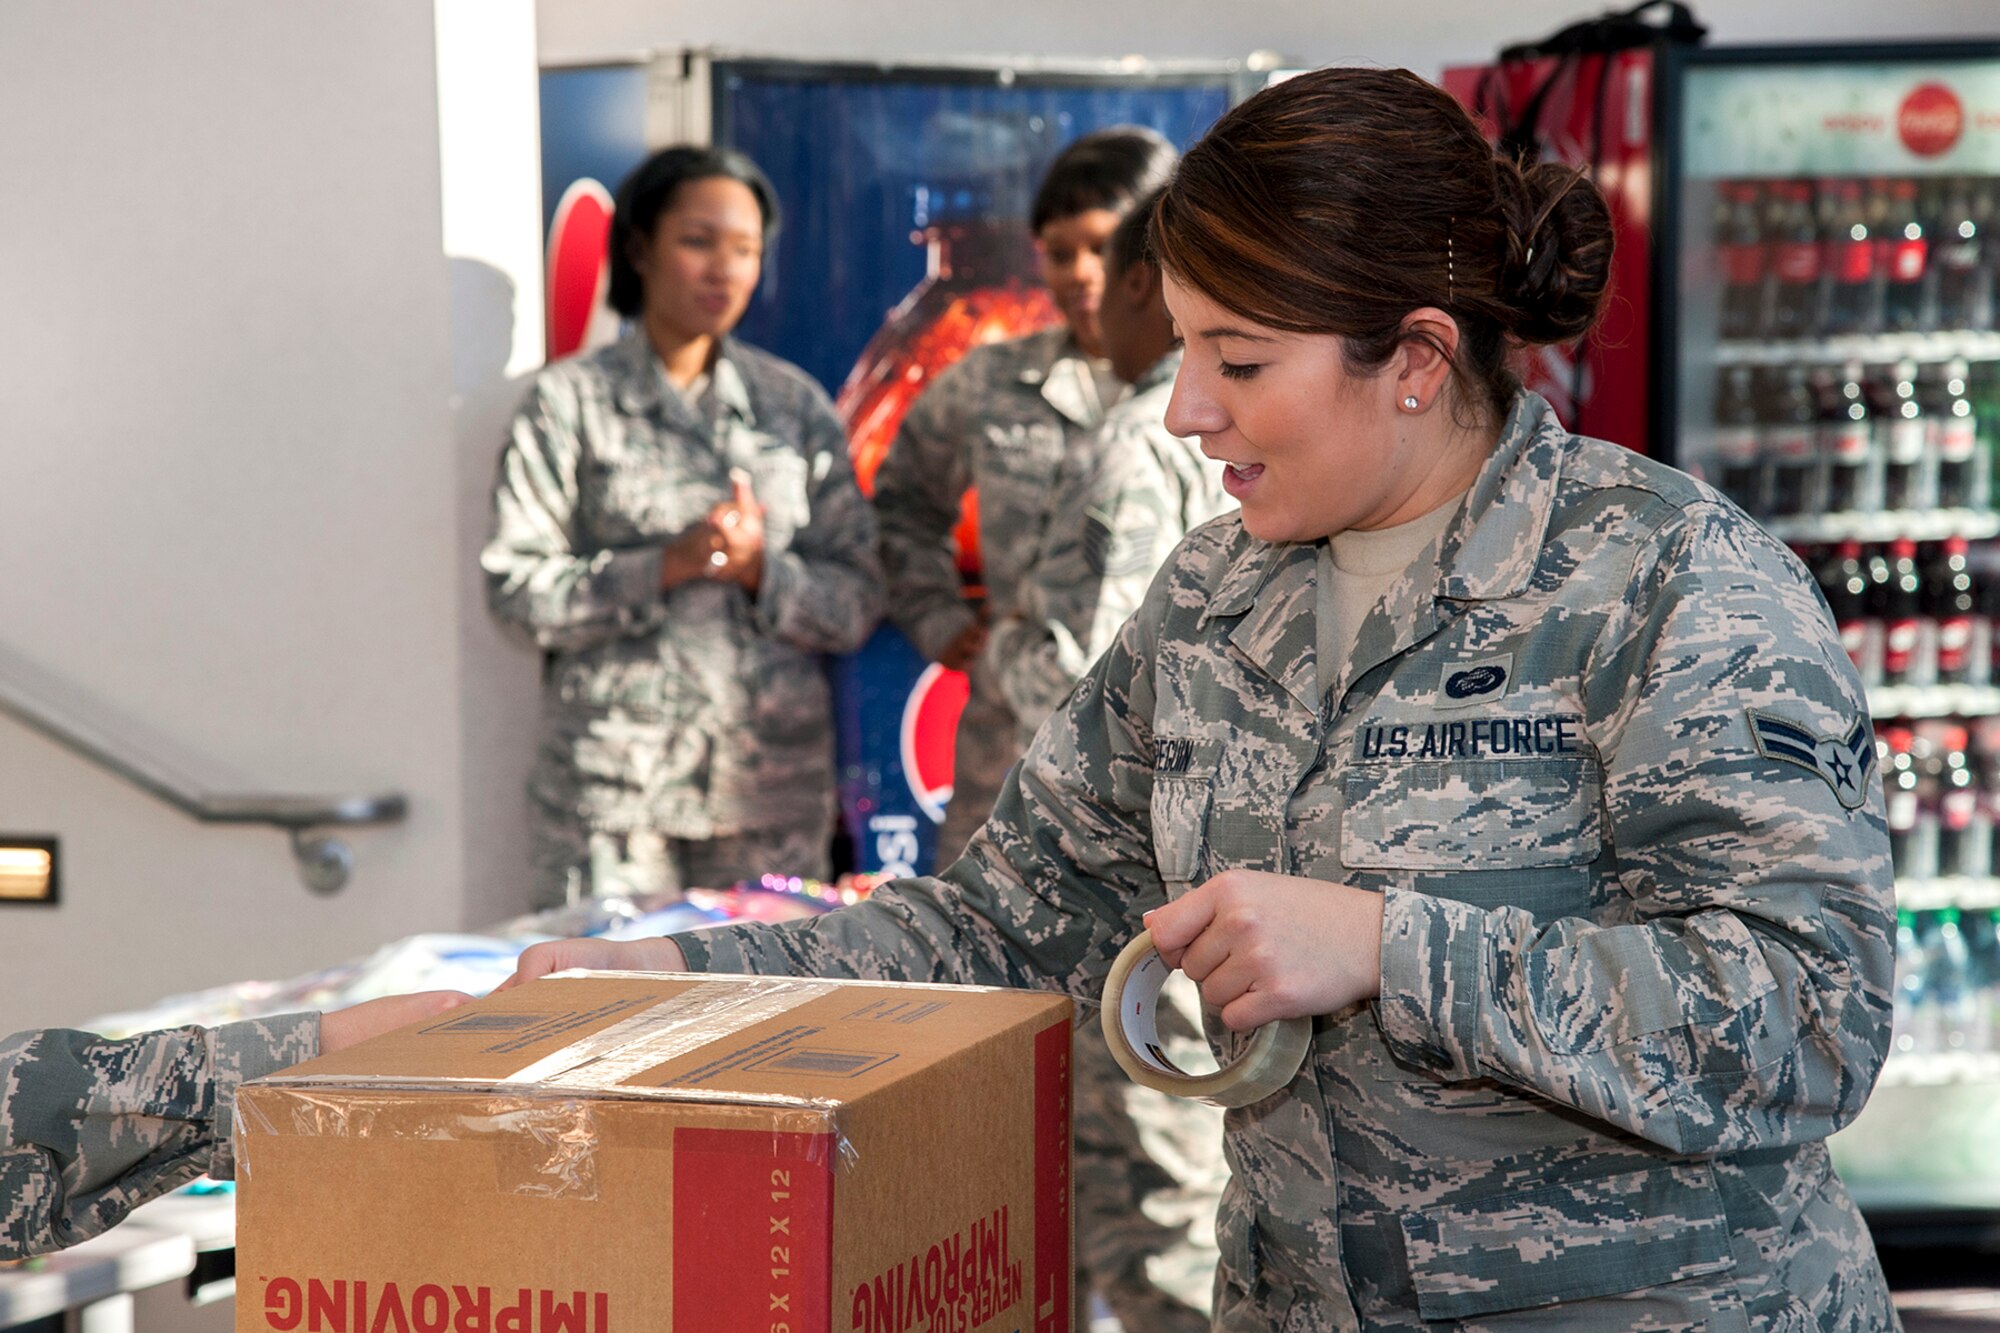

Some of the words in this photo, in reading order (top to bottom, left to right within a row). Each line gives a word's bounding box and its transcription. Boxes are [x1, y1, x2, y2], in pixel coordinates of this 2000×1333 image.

[1362, 726, 1413, 759] U.S.
[1420, 722, 1466, 757] AIR
[1471, 718, 1577, 755] FORCE
[770, 1169, 790, 1203] 12
[769, 1216, 790, 1236] X
[770, 1246, 790, 1280] 12
[852, 1204, 1008, 1333] IMPROVING
[264, 1277, 609, 1333] IMPROVING
[769, 1292, 790, 1313] X
[972, 1259, 1022, 1329] NEVER
